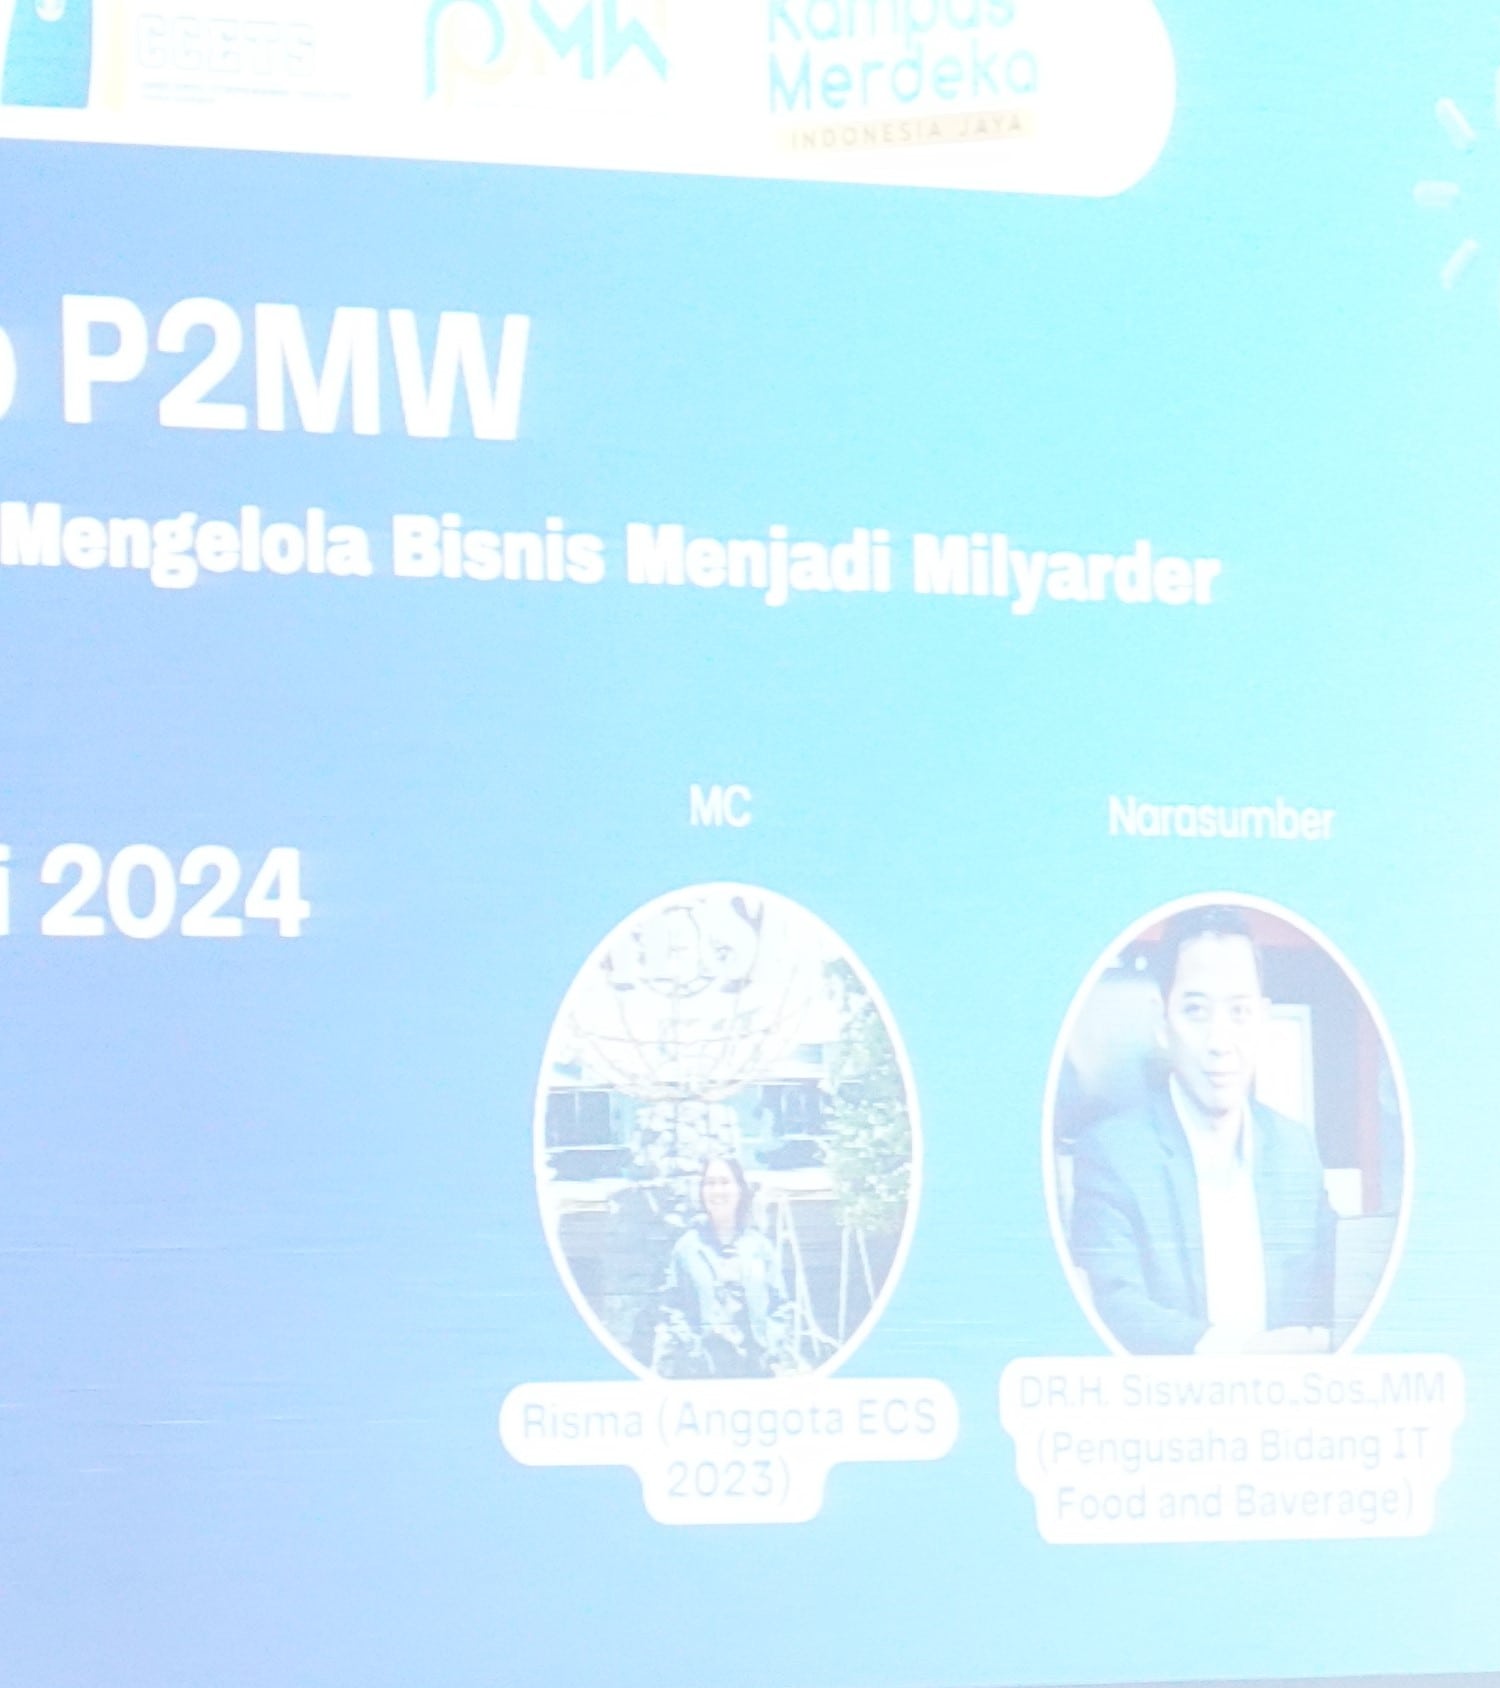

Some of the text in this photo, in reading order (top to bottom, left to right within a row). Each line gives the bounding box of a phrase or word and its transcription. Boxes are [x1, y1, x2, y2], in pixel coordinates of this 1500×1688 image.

[768, 0, 1017, 49] Kampus
[768, 37, 1039, 113] Merdeka
[790, 113, 1024, 149] INDONESIA JAYA
[62, 294, 531, 441] P2MW
[0, 501, 1222, 615] Mengelola Bisnis Menjadi Milyarder
[690, 783, 753, 828] MC
[1109, 790, 1338, 840] Narasumber
[40, 843, 310, 939] 2024
[522, 1397, 937, 1448] Risma (Anggota ECS
[1036, 1427, 1430, 1473] (Pengusaha Bidang IT
[667, 1456, 790, 1505] 2023)
[1056, 1477, 1413, 1524] Food and Baverage)
